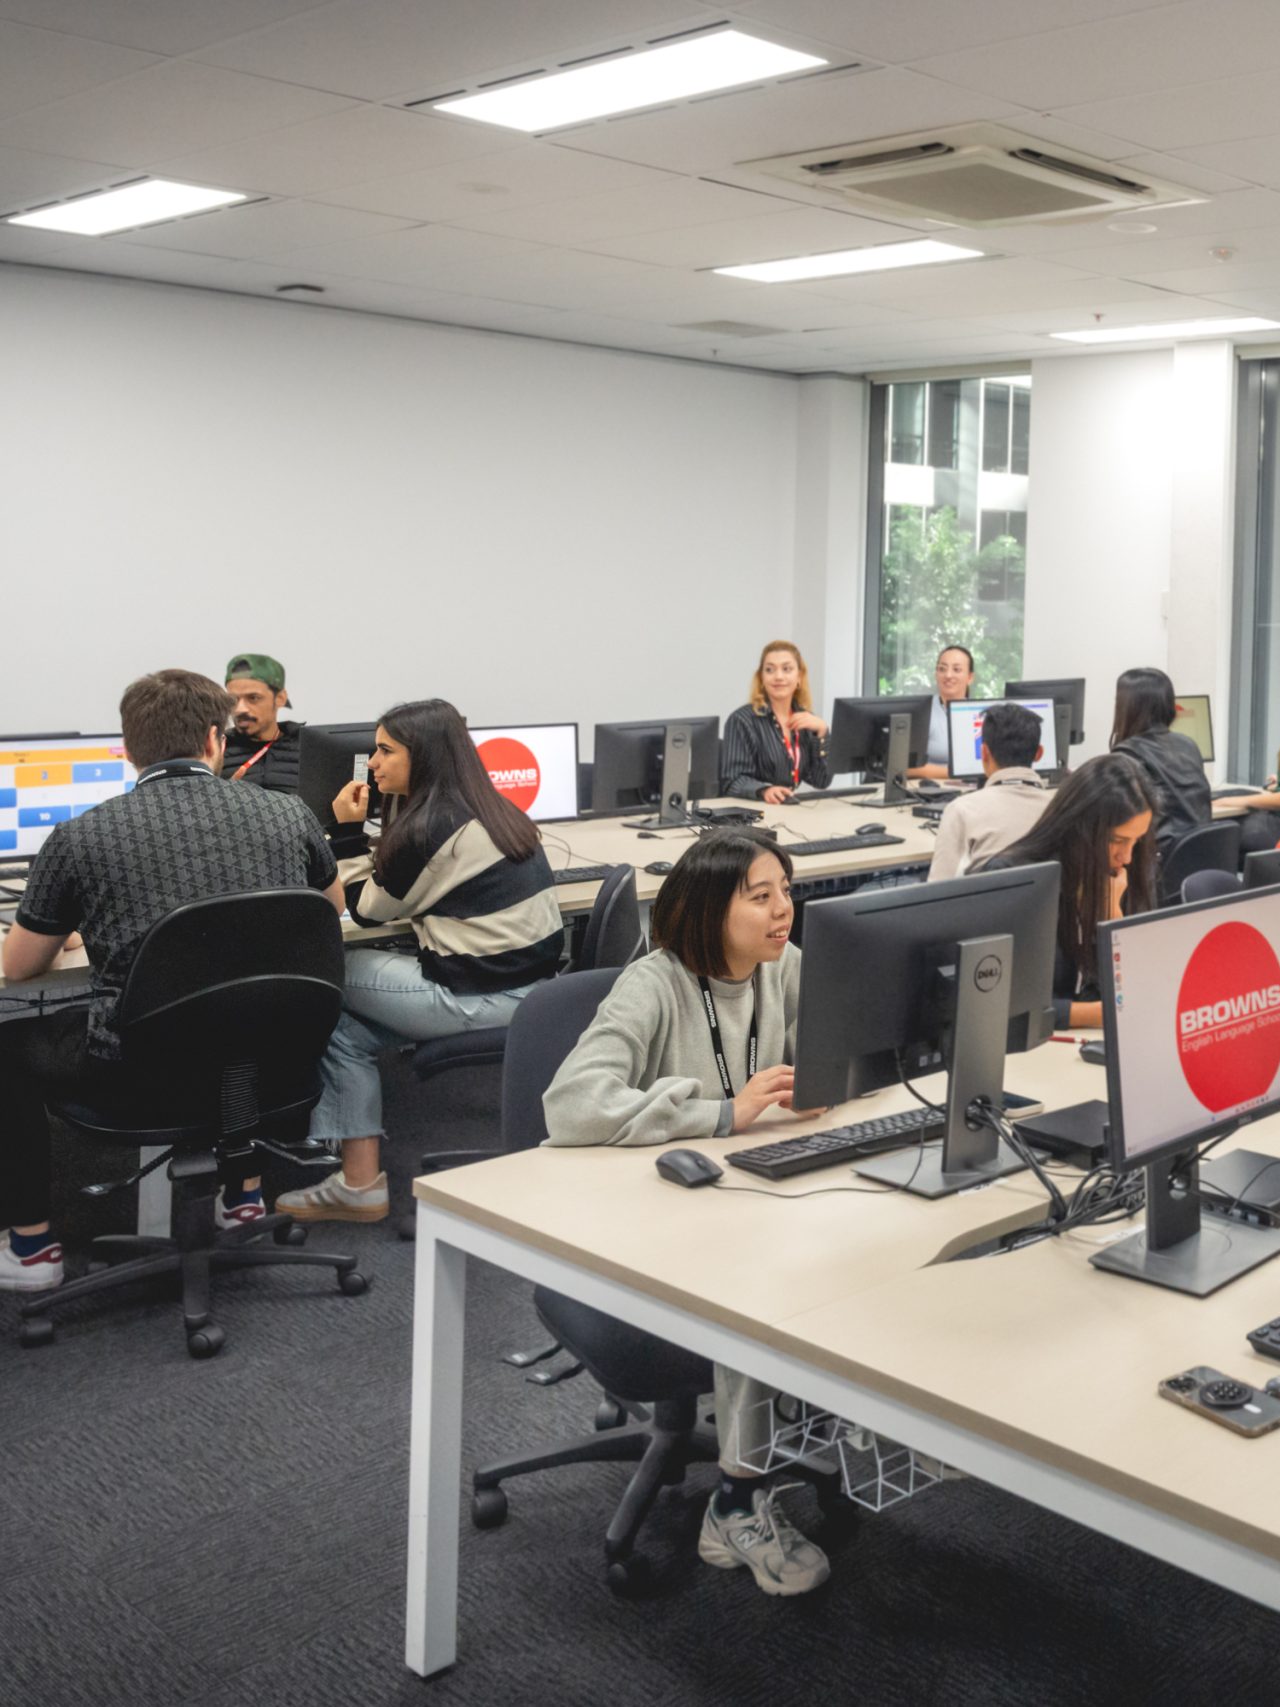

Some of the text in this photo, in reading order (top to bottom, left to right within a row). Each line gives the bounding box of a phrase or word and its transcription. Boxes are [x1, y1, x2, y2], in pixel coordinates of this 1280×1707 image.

[488, 768, 537, 781] OWNS
[703, 990, 717, 1028] BROWNS
[1181, 1035, 1213, 1053] English
[1214, 1020, 1255, 1043] Language
[716, 1053, 730, 1090] BROWNS
[749, 1036, 757, 1076] BROWNS
